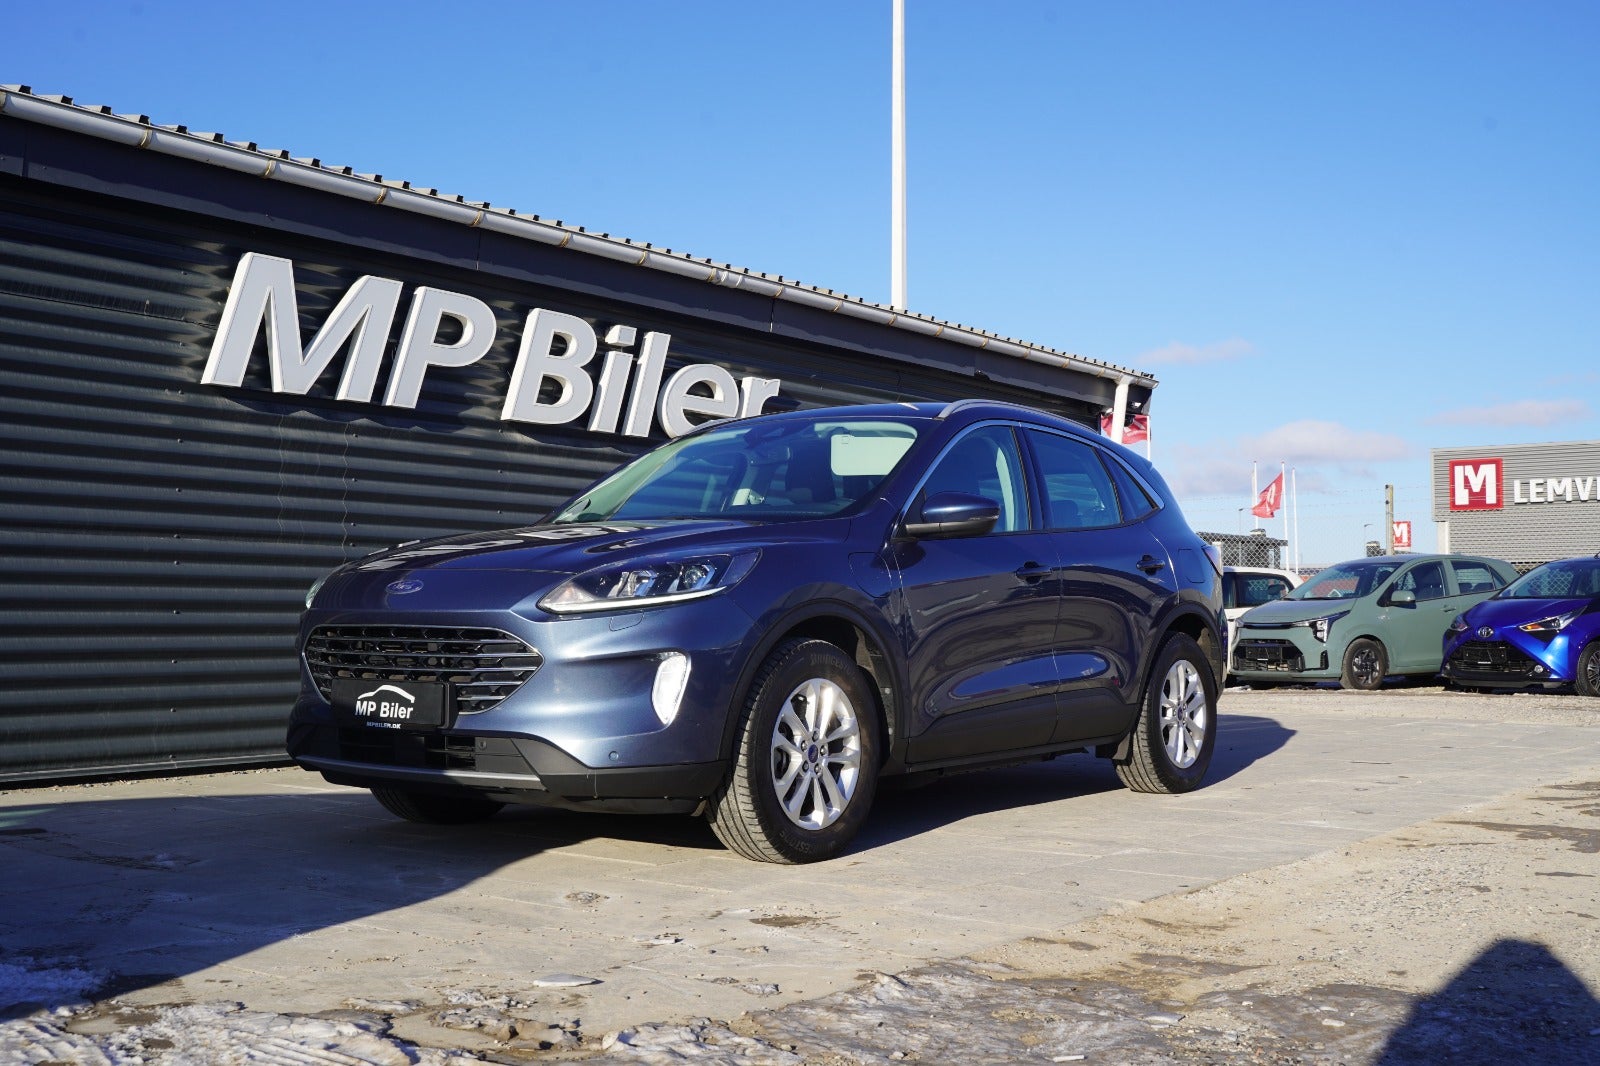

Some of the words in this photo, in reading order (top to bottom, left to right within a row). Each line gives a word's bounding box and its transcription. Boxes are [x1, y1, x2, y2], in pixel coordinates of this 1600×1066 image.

[200, 251, 497, 409] MP
[500, 307, 780, 440] Biler
[355, 700, 377, 717] MP
[379, 701, 414, 719] Biler
